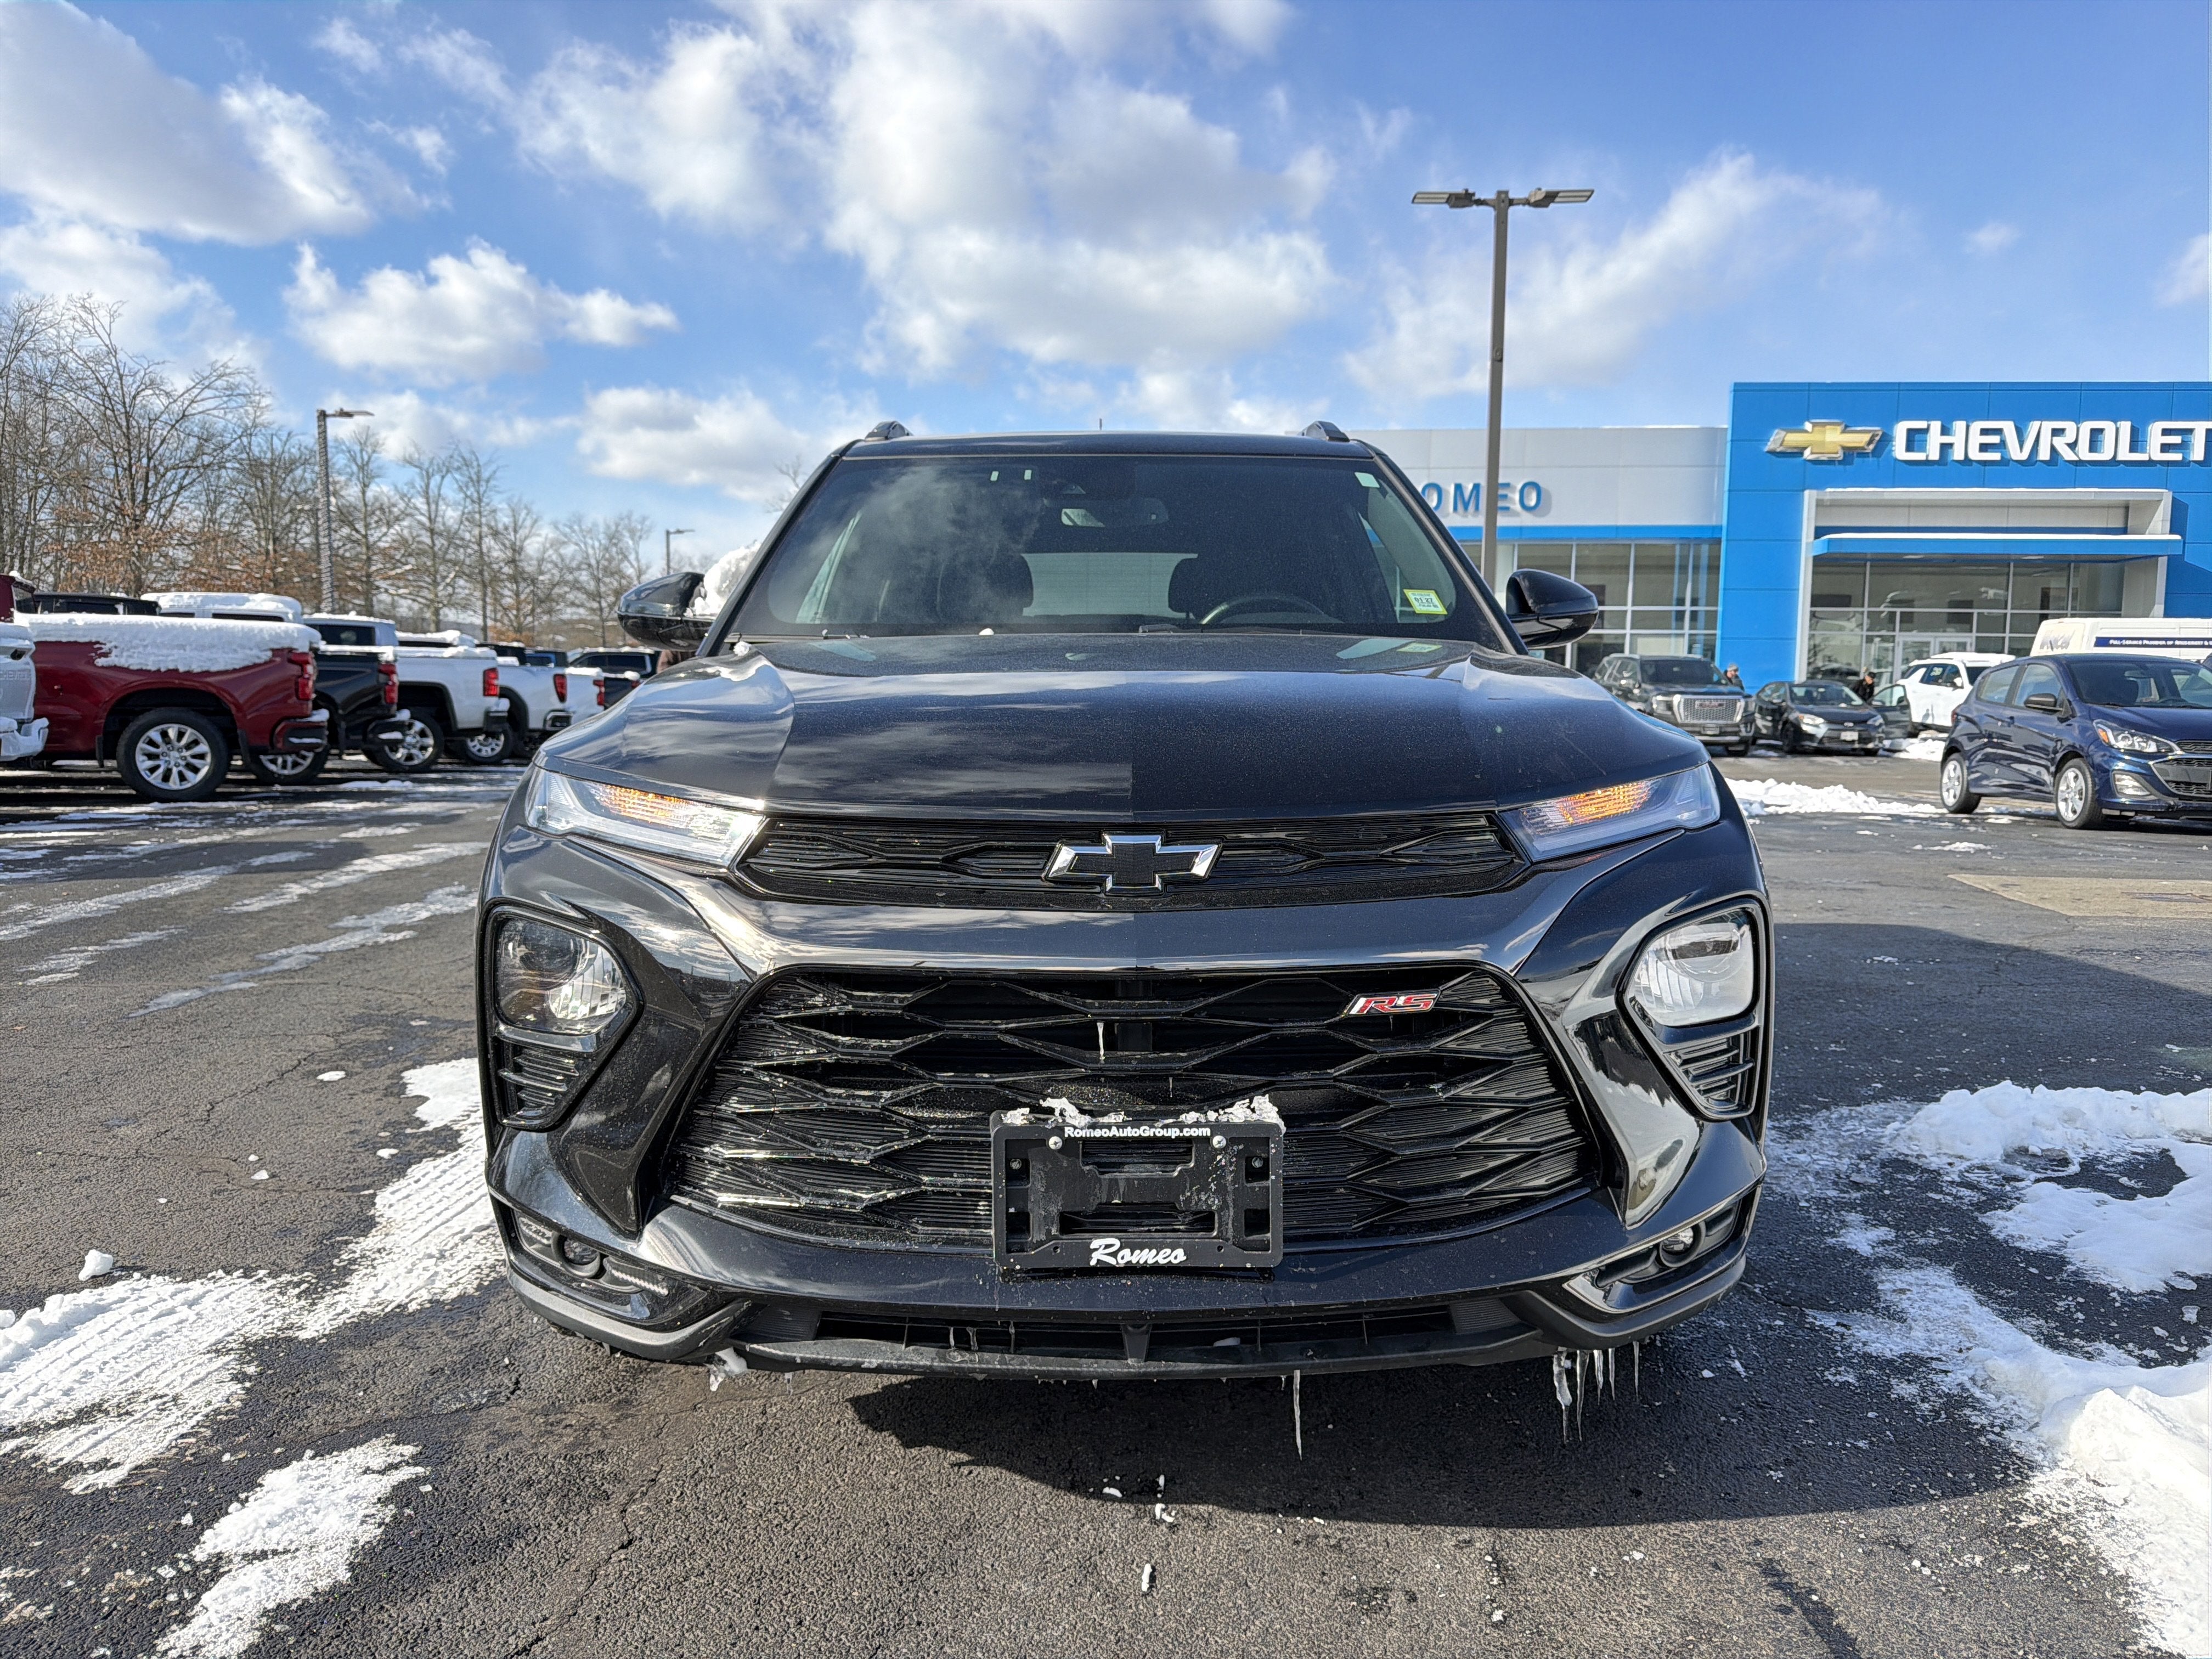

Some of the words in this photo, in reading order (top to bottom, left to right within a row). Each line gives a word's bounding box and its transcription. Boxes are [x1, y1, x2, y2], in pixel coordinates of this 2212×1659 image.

[1895, 421, 2212, 461] CHEVROLET
[1421, 481, 1542, 512] OMEO
[1349, 993, 1437, 1015] RS
[1064, 1126, 1211, 1139] RomeoAutoGroup.com
[1090, 1238, 1187, 1266] Romeo
